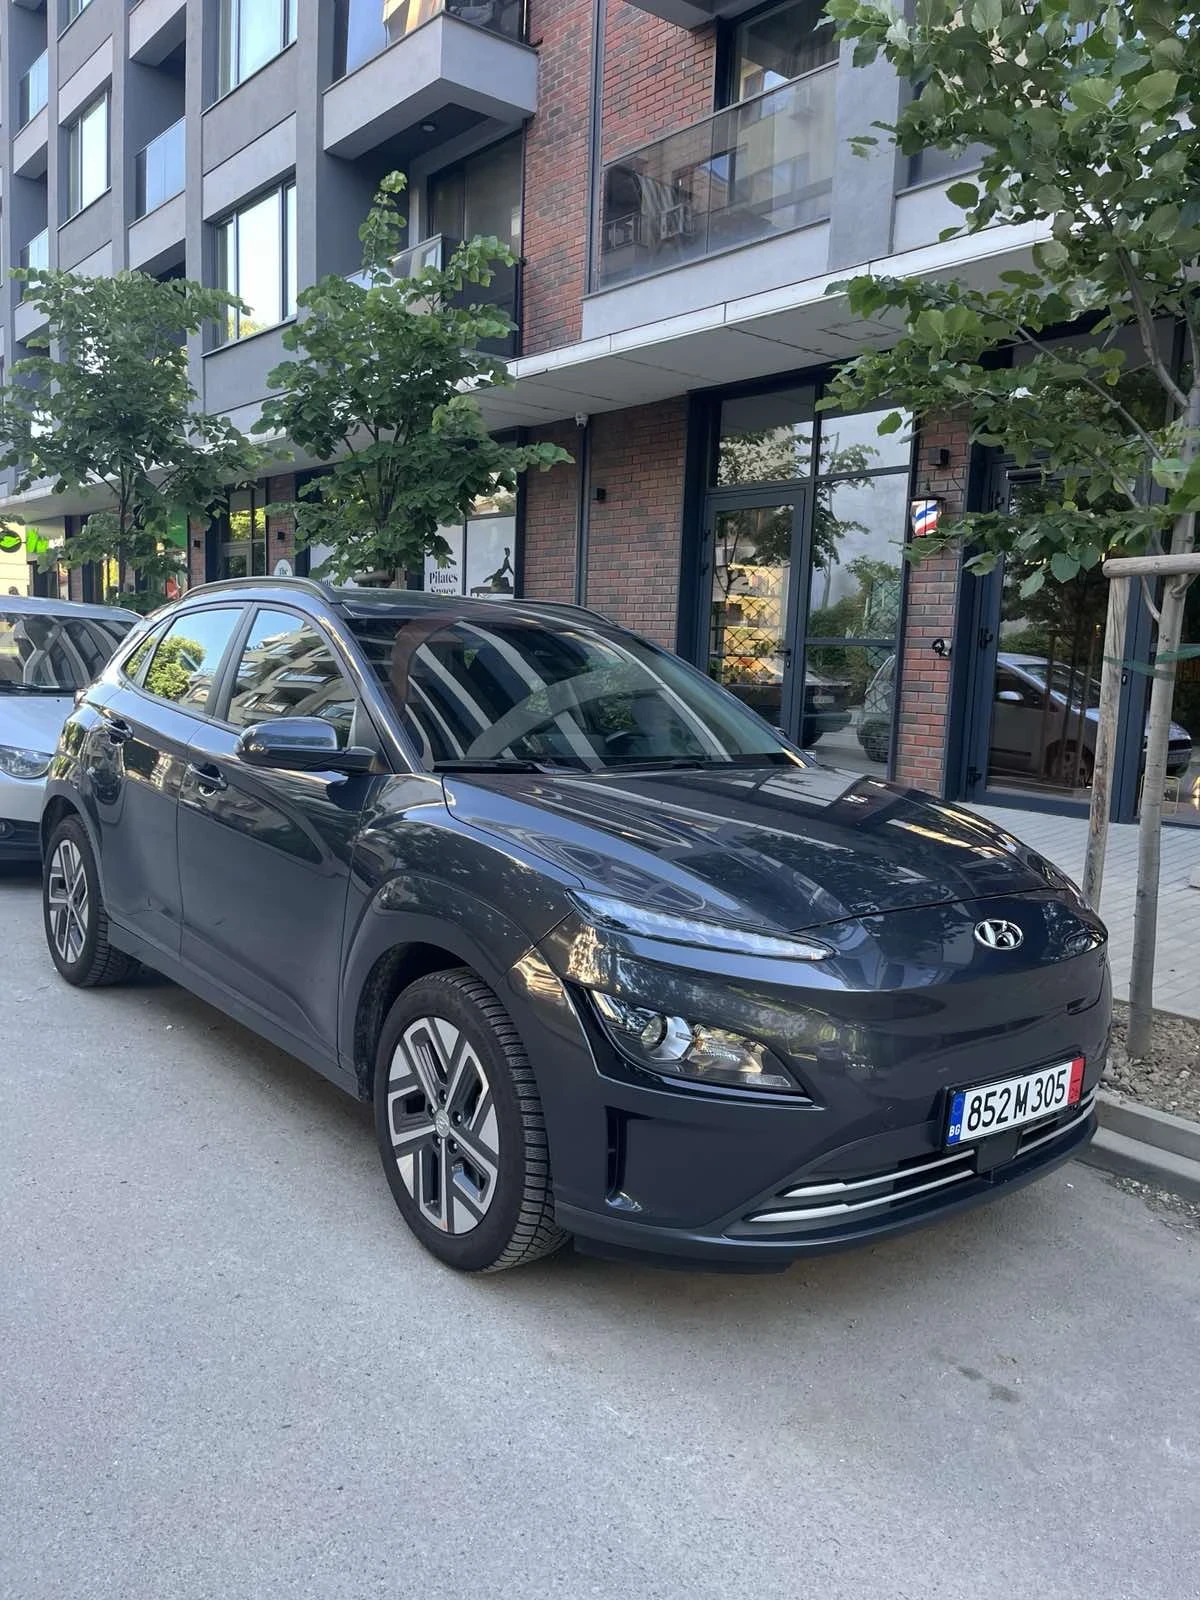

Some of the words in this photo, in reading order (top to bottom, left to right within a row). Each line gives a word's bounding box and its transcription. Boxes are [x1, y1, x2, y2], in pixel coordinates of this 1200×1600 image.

[429, 570, 458, 585] Pilates
[967, 1087, 1011, 1132] 852
[1013, 1080, 1030, 1119] M
[1030, 1069, 1067, 1113] 305
[948, 1123, 961, 1137] BG
